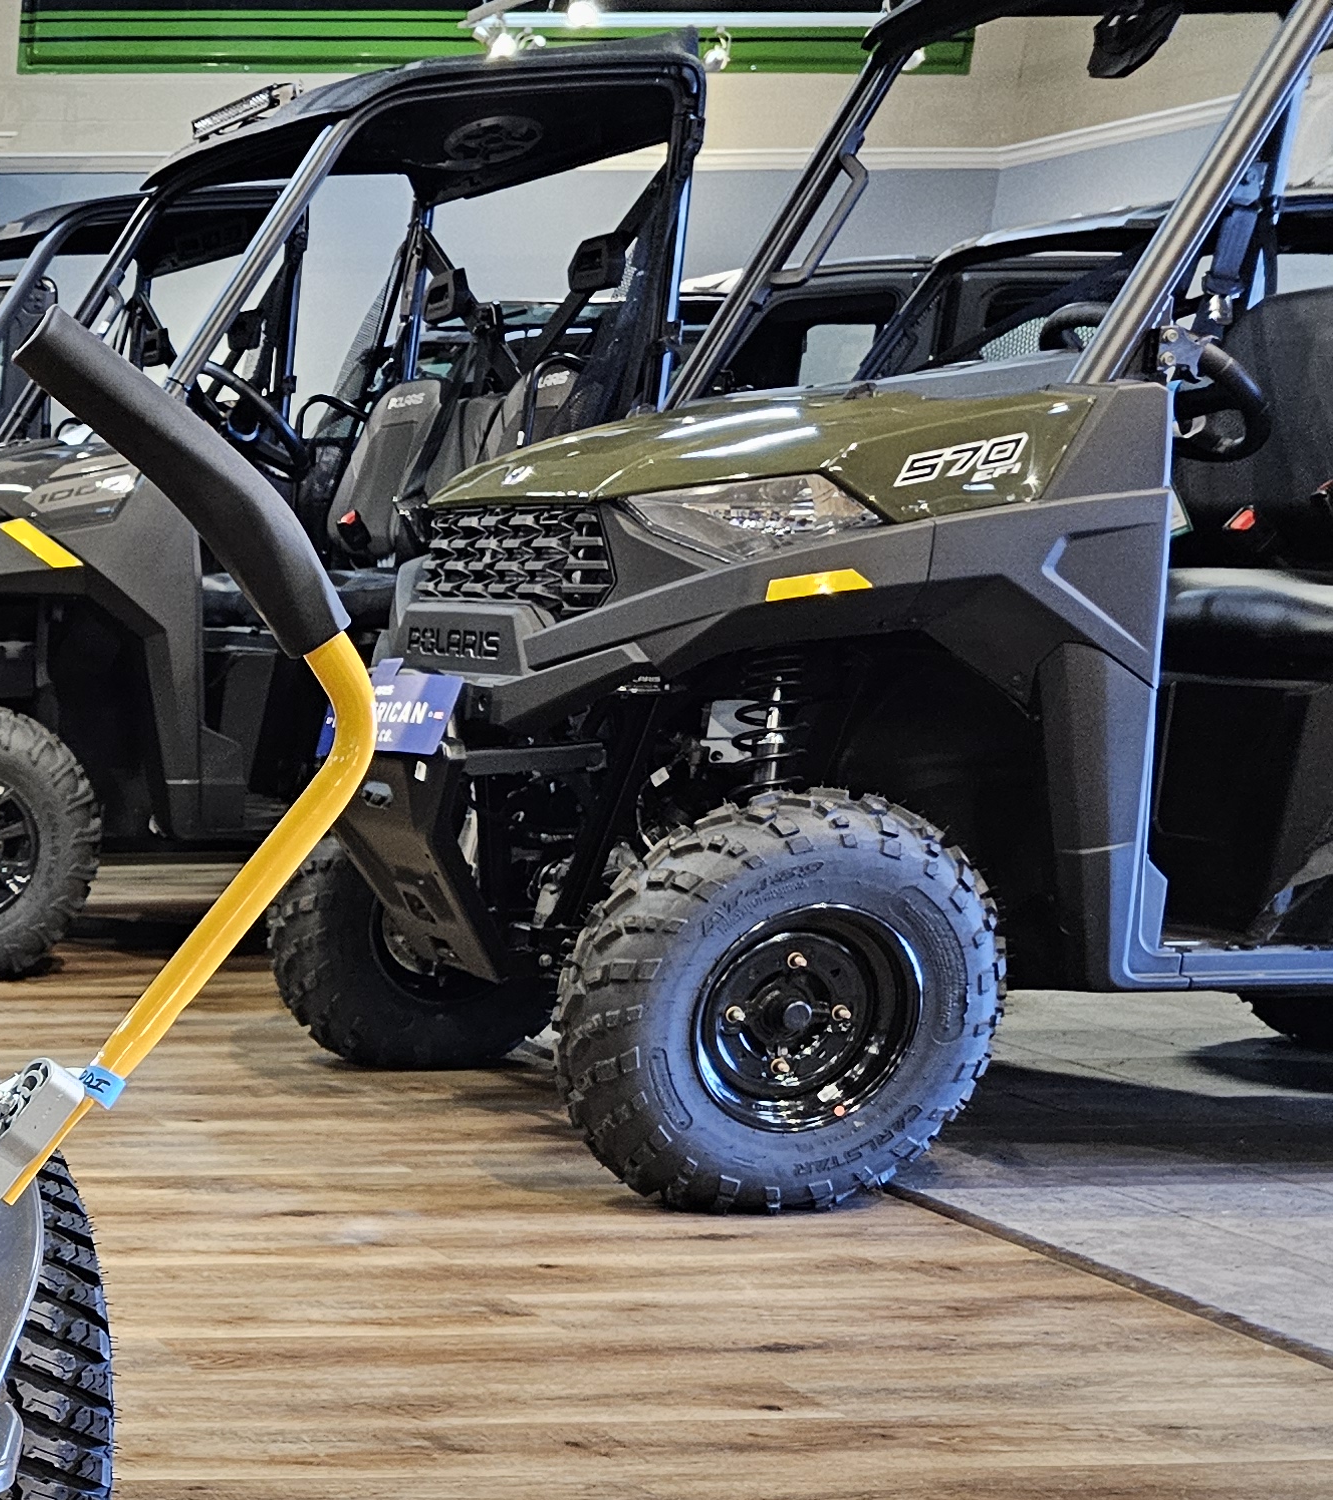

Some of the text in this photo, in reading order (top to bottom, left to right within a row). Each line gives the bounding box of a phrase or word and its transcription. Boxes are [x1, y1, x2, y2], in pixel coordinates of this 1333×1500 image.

[893, 431, 1030, 488] 570
[970, 462, 1022, 483] EFI
[406, 626, 501, 661] POLARIS
